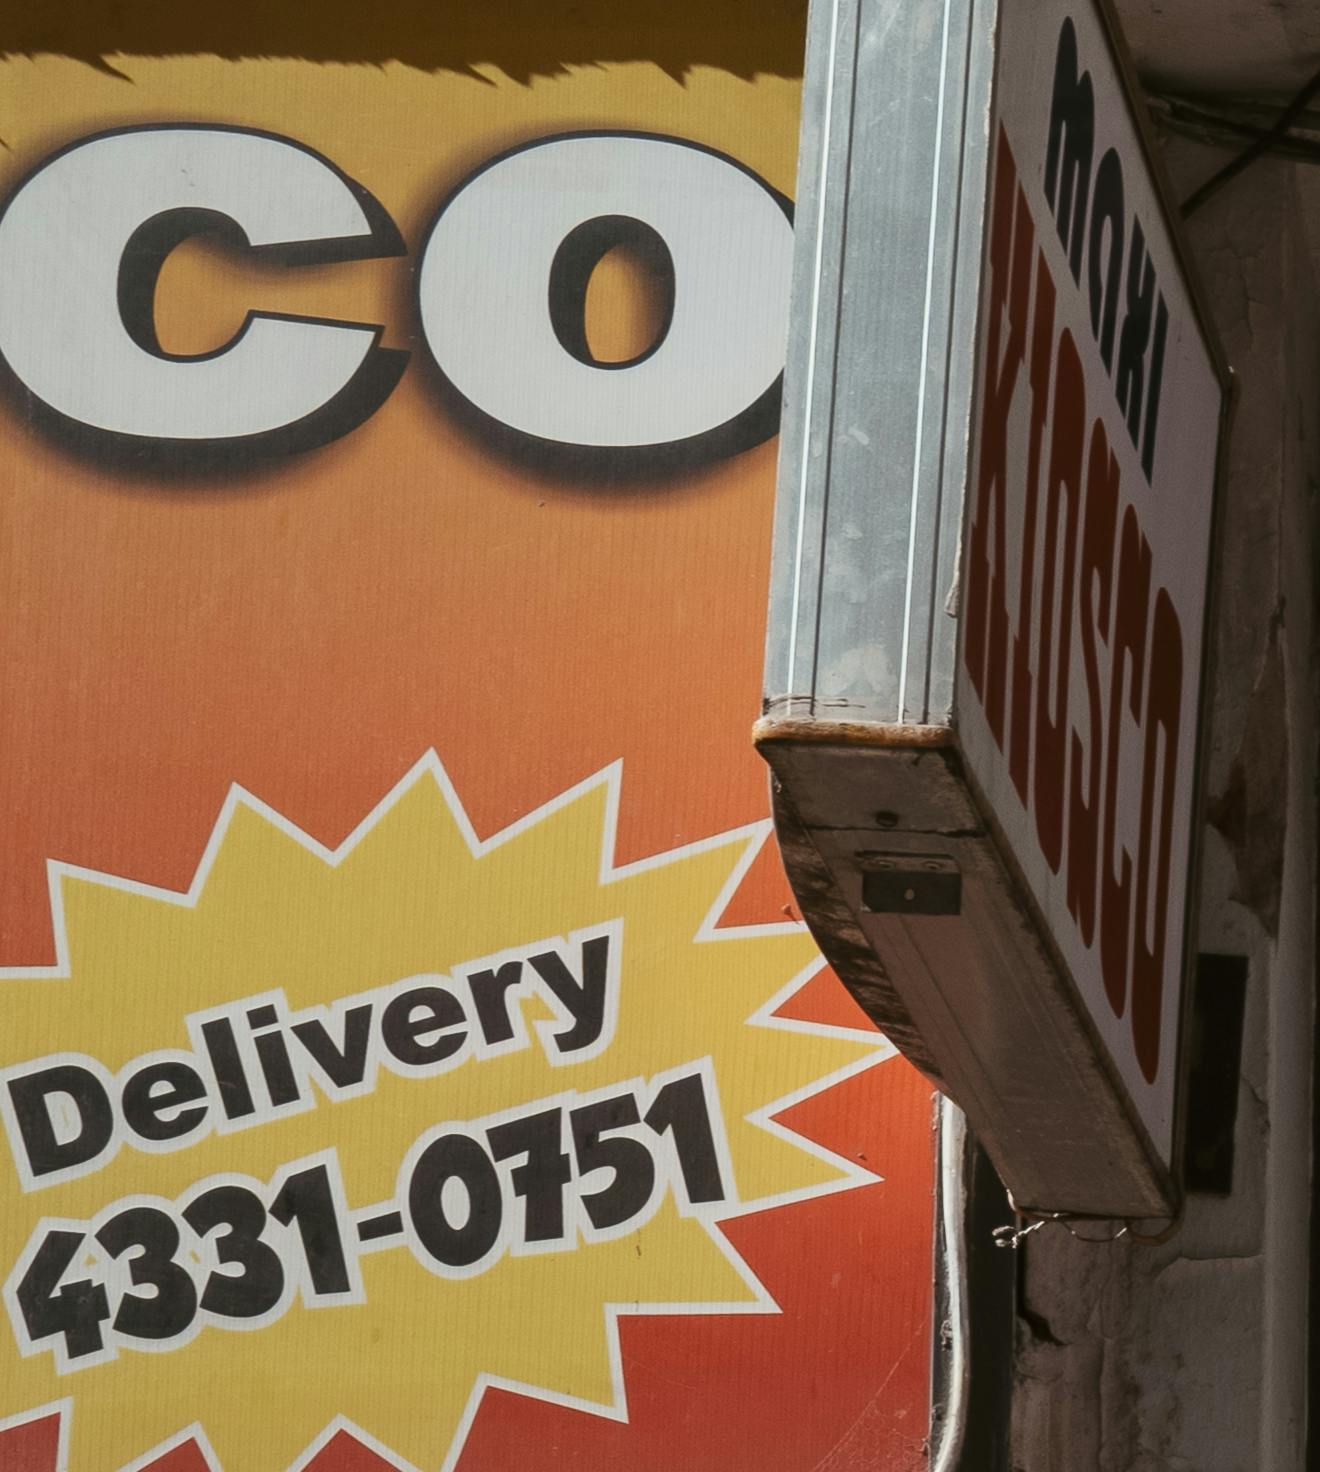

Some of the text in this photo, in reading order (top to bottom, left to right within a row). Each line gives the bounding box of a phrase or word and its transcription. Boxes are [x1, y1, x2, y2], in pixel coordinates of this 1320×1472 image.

[0, 123, 797, 458] CO
[964, 117, 1182, 1085] KIOSCO
[7, 934, 611, 1178] Delivery
[16, 1072, 726, 1360] 4331-0751
